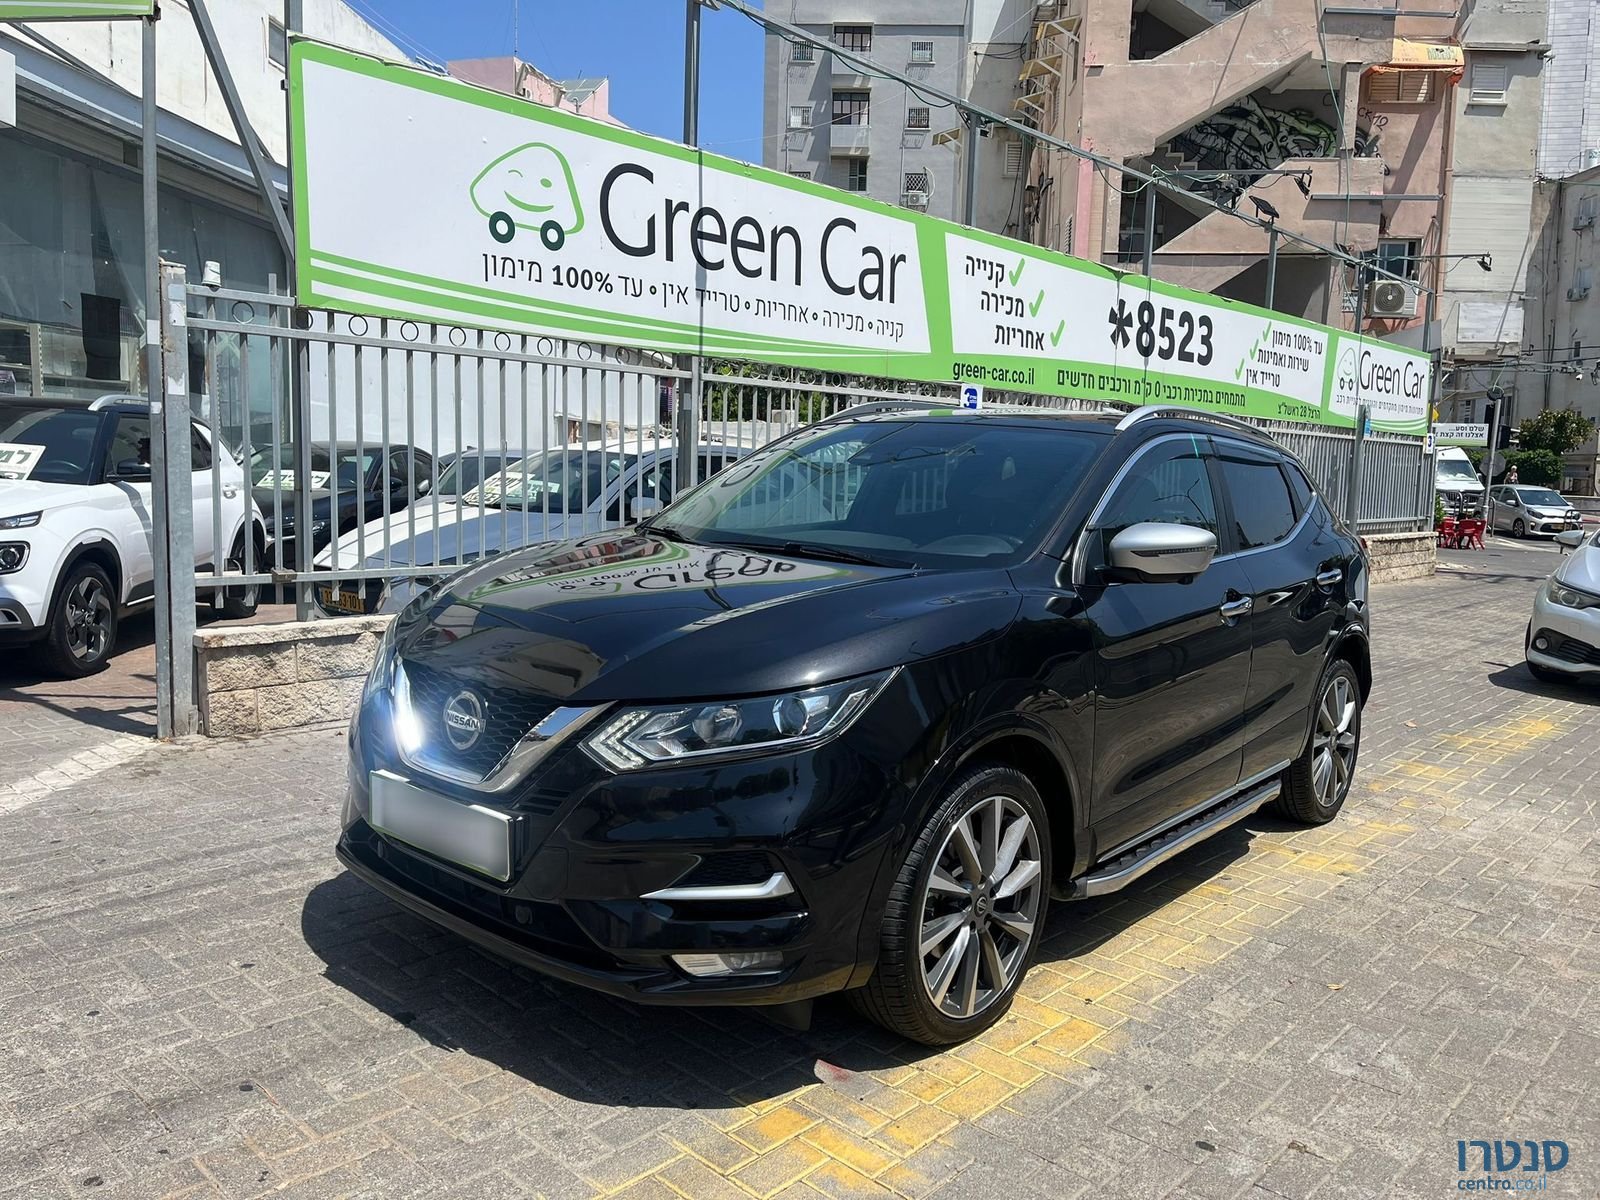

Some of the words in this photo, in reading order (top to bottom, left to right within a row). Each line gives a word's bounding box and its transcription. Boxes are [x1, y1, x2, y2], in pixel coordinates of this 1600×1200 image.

[599, 163, 802, 286] Green
[820, 217, 906, 304] Car
[482, 253, 543, 283] מימון
[965, 255, 1005, 289] קנייה
[552, 265, 614, 294] 100%
[618, 275, 643, 298] עד
[661, 282, 689, 309] אין
[695, 288, 741, 313] טרייד
[980, 290, 1025, 318] מכירה
[754, 298, 809, 324] אחריות
[822, 309, 865, 333] מכירה
[877, 318, 905, 343] קניה
[994, 324, 1045, 351] אחריות
[1272, 330, 1292, 348] מימון
[1294, 333, 1313, 353] 100%
[1314, 341, 1323, 355] עד
[1257, 348, 1287, 368] ואמינות
[1287, 355, 1310, 372] שירות
[952, 362, 1035, 385] green-car.co.il
[1057, 369, 1095, 389] חדשים
[1246, 368, 1258, 387] אין
[1260, 371, 1281, 388] טרייד
[1360, 350, 1400, 395] Green
[1403, 361, 1425, 399] Car
[1098, 375, 1131, 394] ורכבים
[1154, 380, 1161, 398] 0
[1163, 384, 1182, 400] רכבי
[1183, 388, 1214, 403] במכירת
[1215, 391, 1246, 407] מתמחים
[447, 711, 480, 729] NISSAN
